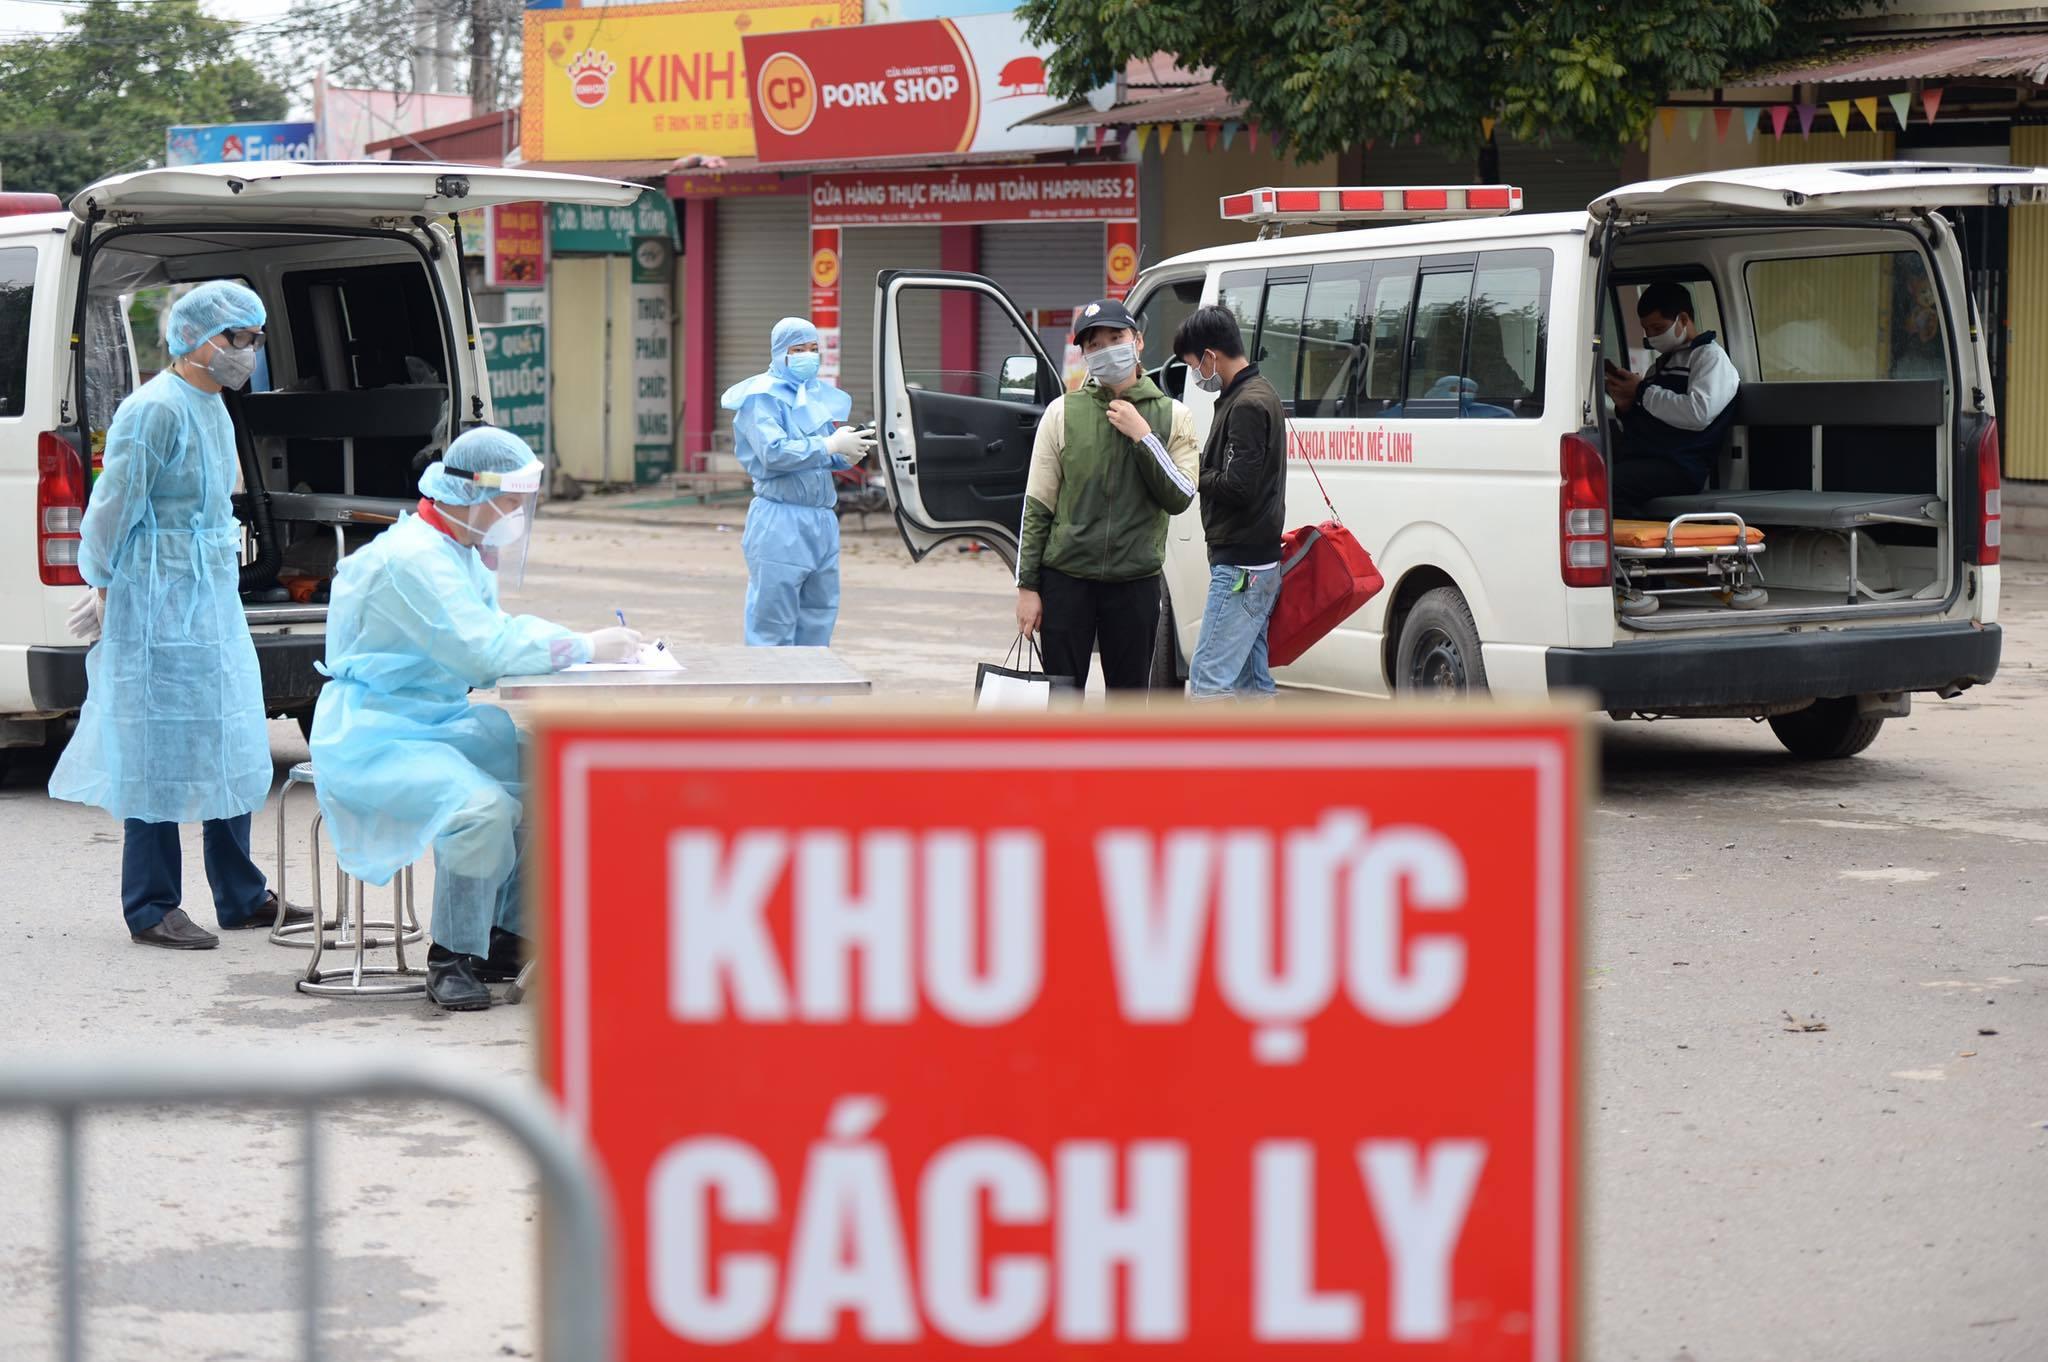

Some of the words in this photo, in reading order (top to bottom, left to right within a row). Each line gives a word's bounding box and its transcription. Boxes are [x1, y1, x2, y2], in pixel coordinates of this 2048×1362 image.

[629, 51, 735, 104] KINH
[767, 76, 806, 111] CP
[822, 80, 889, 108] PORK
[893, 75, 960, 103] SHOP
[813, 180, 843, 206] CỬA
[845, 180, 886, 206] HÀNG
[888, 182, 927, 209] THỰC
[929, 173, 972, 204] PHẨM
[974, 181, 996, 202] AN
[998, 175, 1039, 202] TOÀN
[1041, 178, 1122, 200] HAPPINESS
[1124, 177, 1135, 198] 2
[1111, 255, 1132, 271] CP
[1286, 431, 1296, 460] A
[1298, 431, 1326, 460] KHOA
[1367, 425, 1384, 462] MÊ
[1387, 431, 1413, 463] LINH
[667, 826, 1044, 1026] KHU
[1094, 806, 1469, 1065] VỰC
[647, 1094, 1190, 1345] CÁCH
[1251, 1138, 1489, 1344] LY
